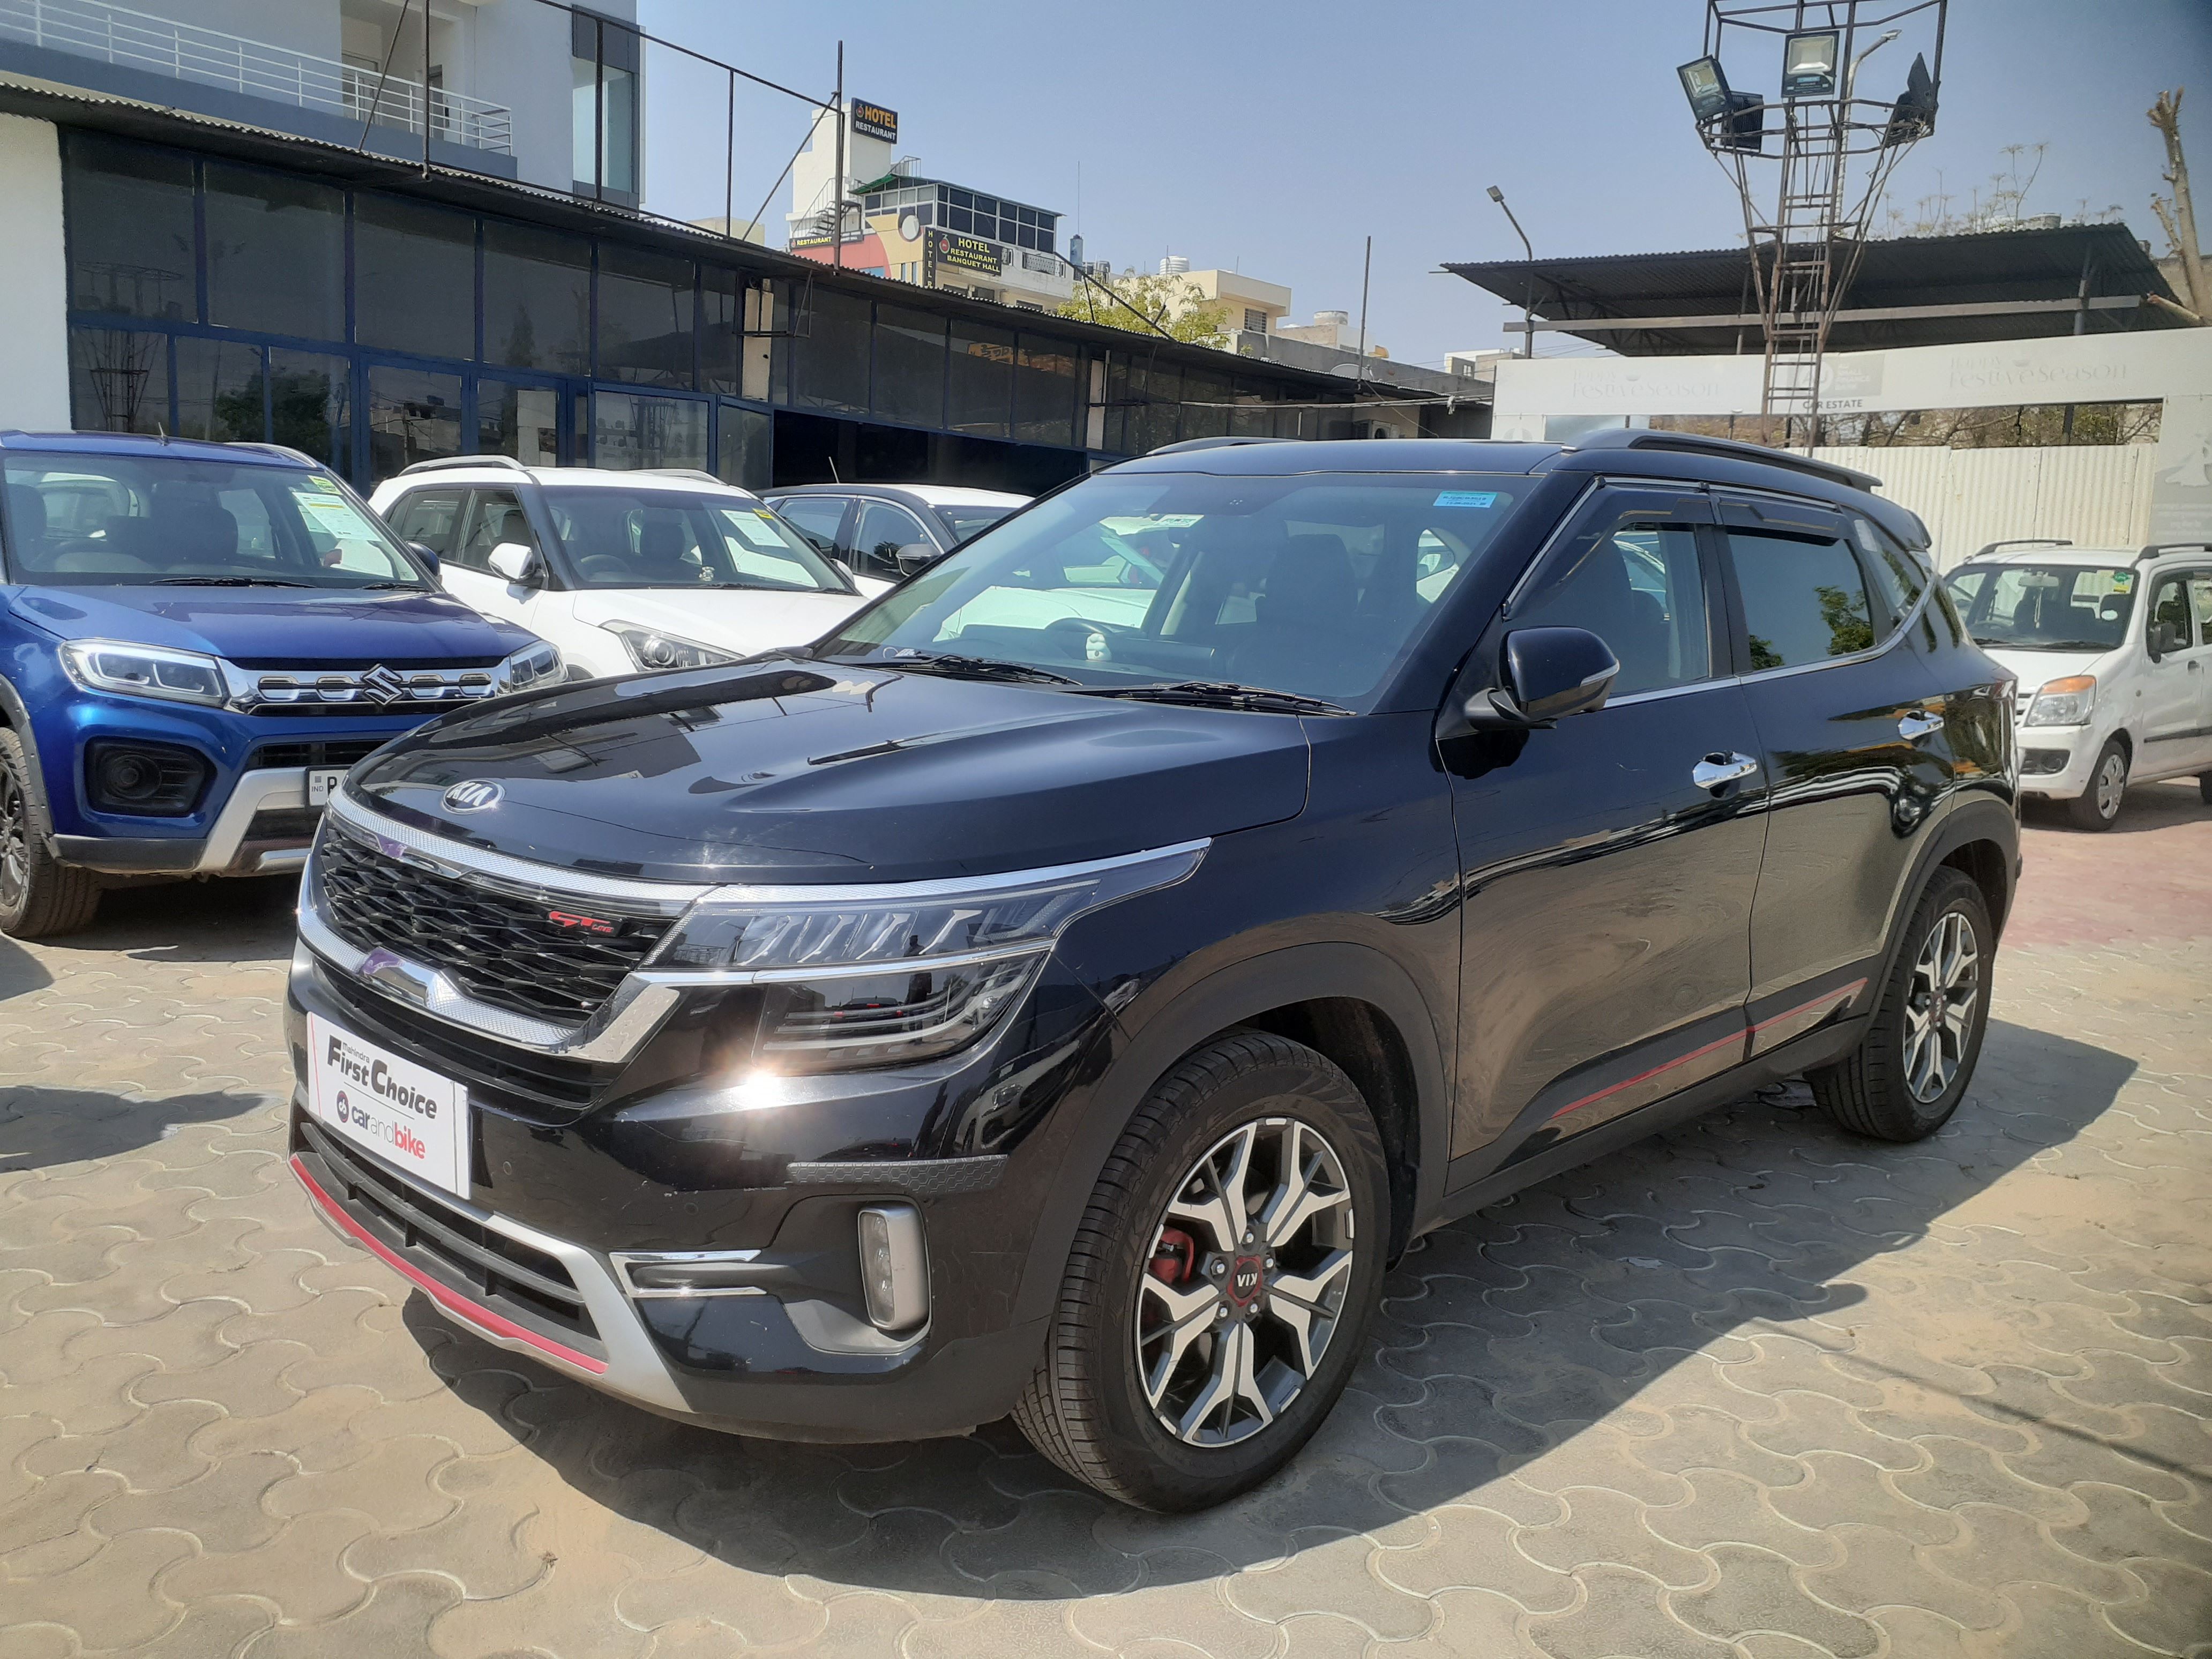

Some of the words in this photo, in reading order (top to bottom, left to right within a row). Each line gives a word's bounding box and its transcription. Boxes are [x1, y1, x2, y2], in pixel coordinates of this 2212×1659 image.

[865, 106, 896, 129] HOTEL
[855, 121, 896, 140] RESTAURANT
[797, 236, 832, 246] RESTAURANT
[958, 237, 990, 253] HOTEL
[947, 255, 981, 268] BANQUET
[982, 263, 1000, 273] HALL
[950, 248, 997, 264] RESTAURANT
[1803, 401, 1823, 409] CR
[1826, 399, 1863, 409] ESTATE
[446, 782, 493, 806] KIA
[342, 1042, 370, 1064] mahindra
[327, 1035, 370, 1087] First
[371, 1059, 437, 1119] Choice
[352, 1104, 425, 1160] carandbike
[1237, 1272, 1258, 1287] KIA
